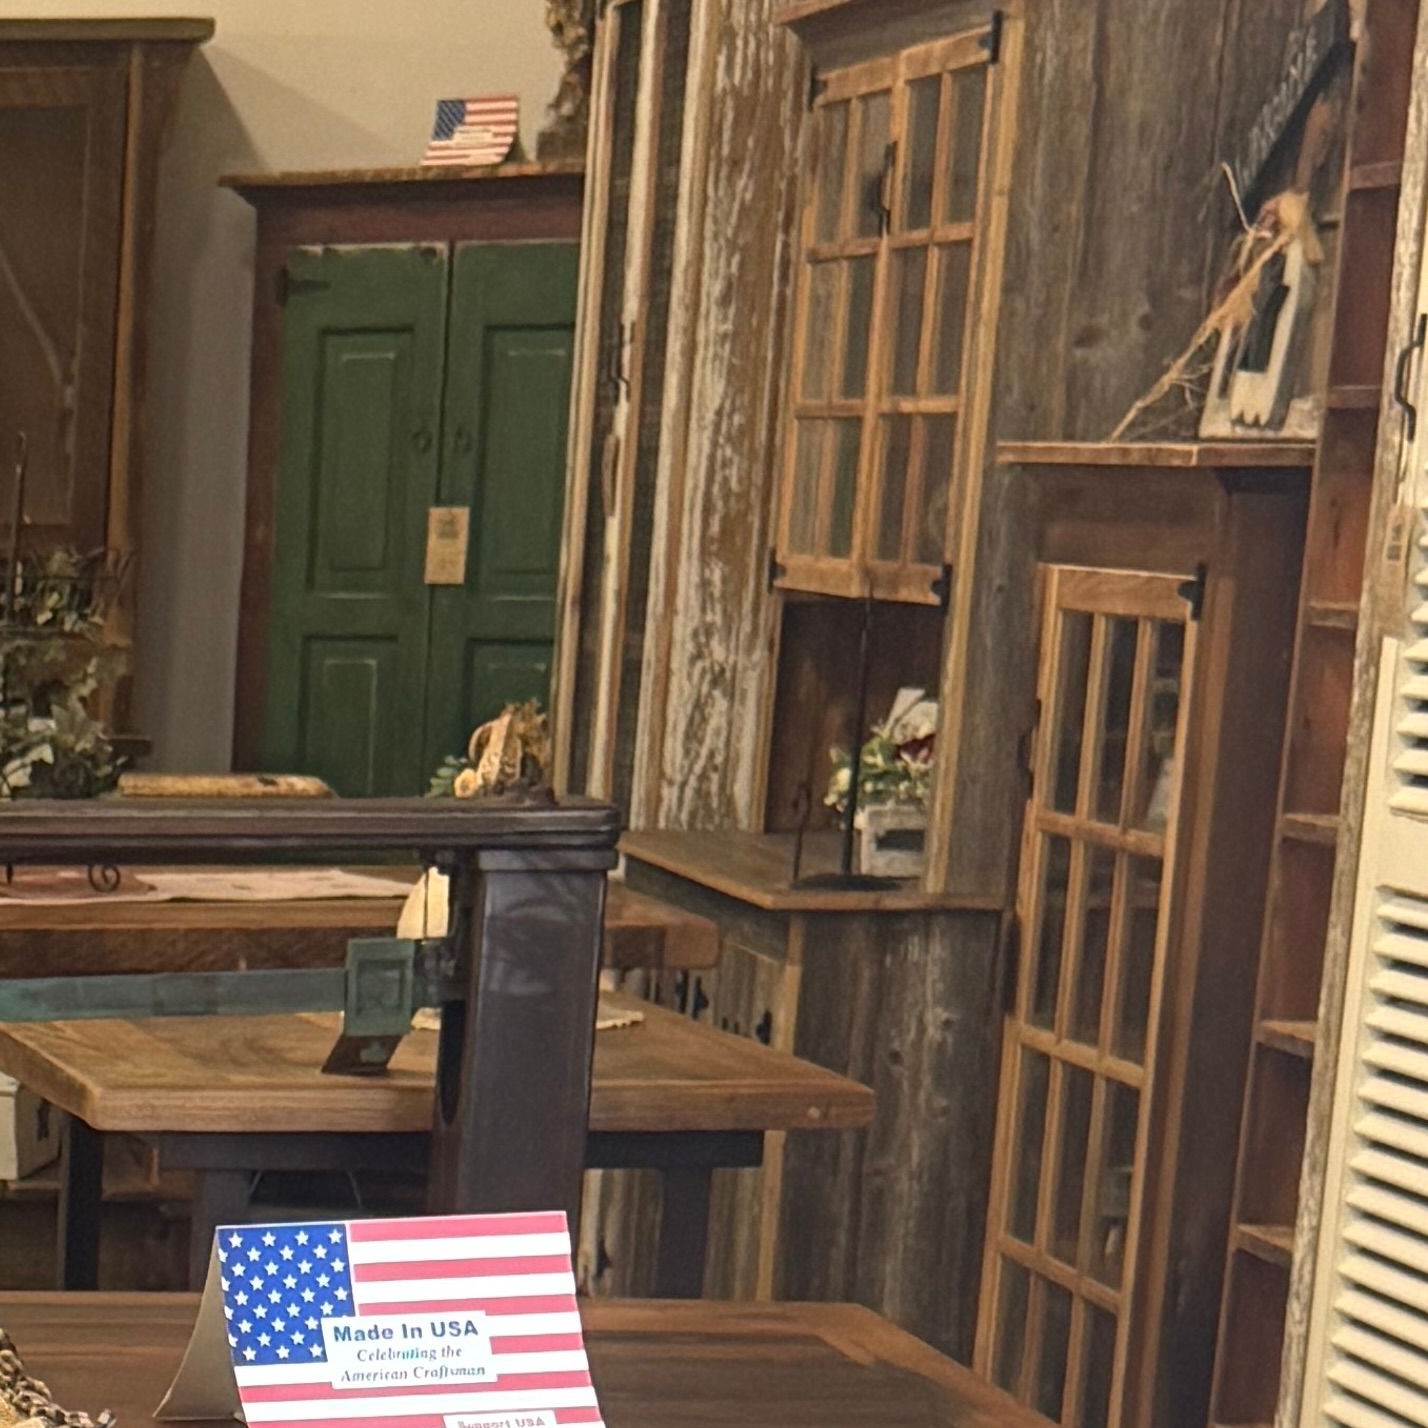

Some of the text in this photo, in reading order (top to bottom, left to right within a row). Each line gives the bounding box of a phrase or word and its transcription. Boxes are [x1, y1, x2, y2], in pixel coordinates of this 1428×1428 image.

[333, 1320, 479, 1342] Made In USA
[356, 1345, 462, 1362] Celebrating the
[340, 1364, 486, 1383] American Craftsman
[514, 1416, 546, 1428] USA
